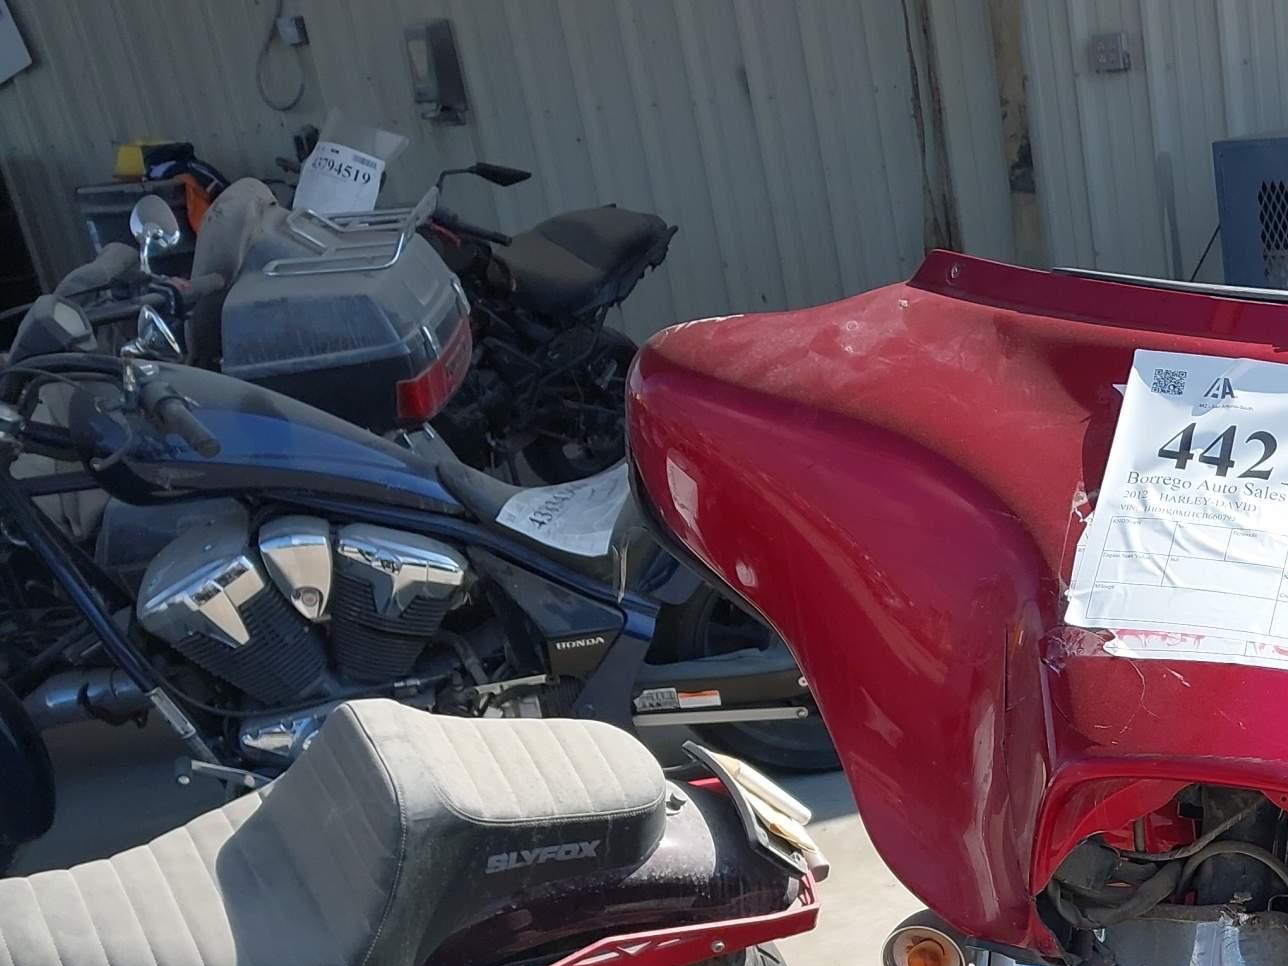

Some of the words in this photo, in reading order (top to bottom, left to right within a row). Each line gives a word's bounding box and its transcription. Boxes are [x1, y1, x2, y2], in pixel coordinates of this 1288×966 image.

[1127, 471, 1192, 491] Borrego
[1199, 480, 1238, 495] Auto
[1244, 482, 1287, 503] Sales
[556, 636, 605, 650] HONDA
[485, 840, 600, 874] SLYFOX
